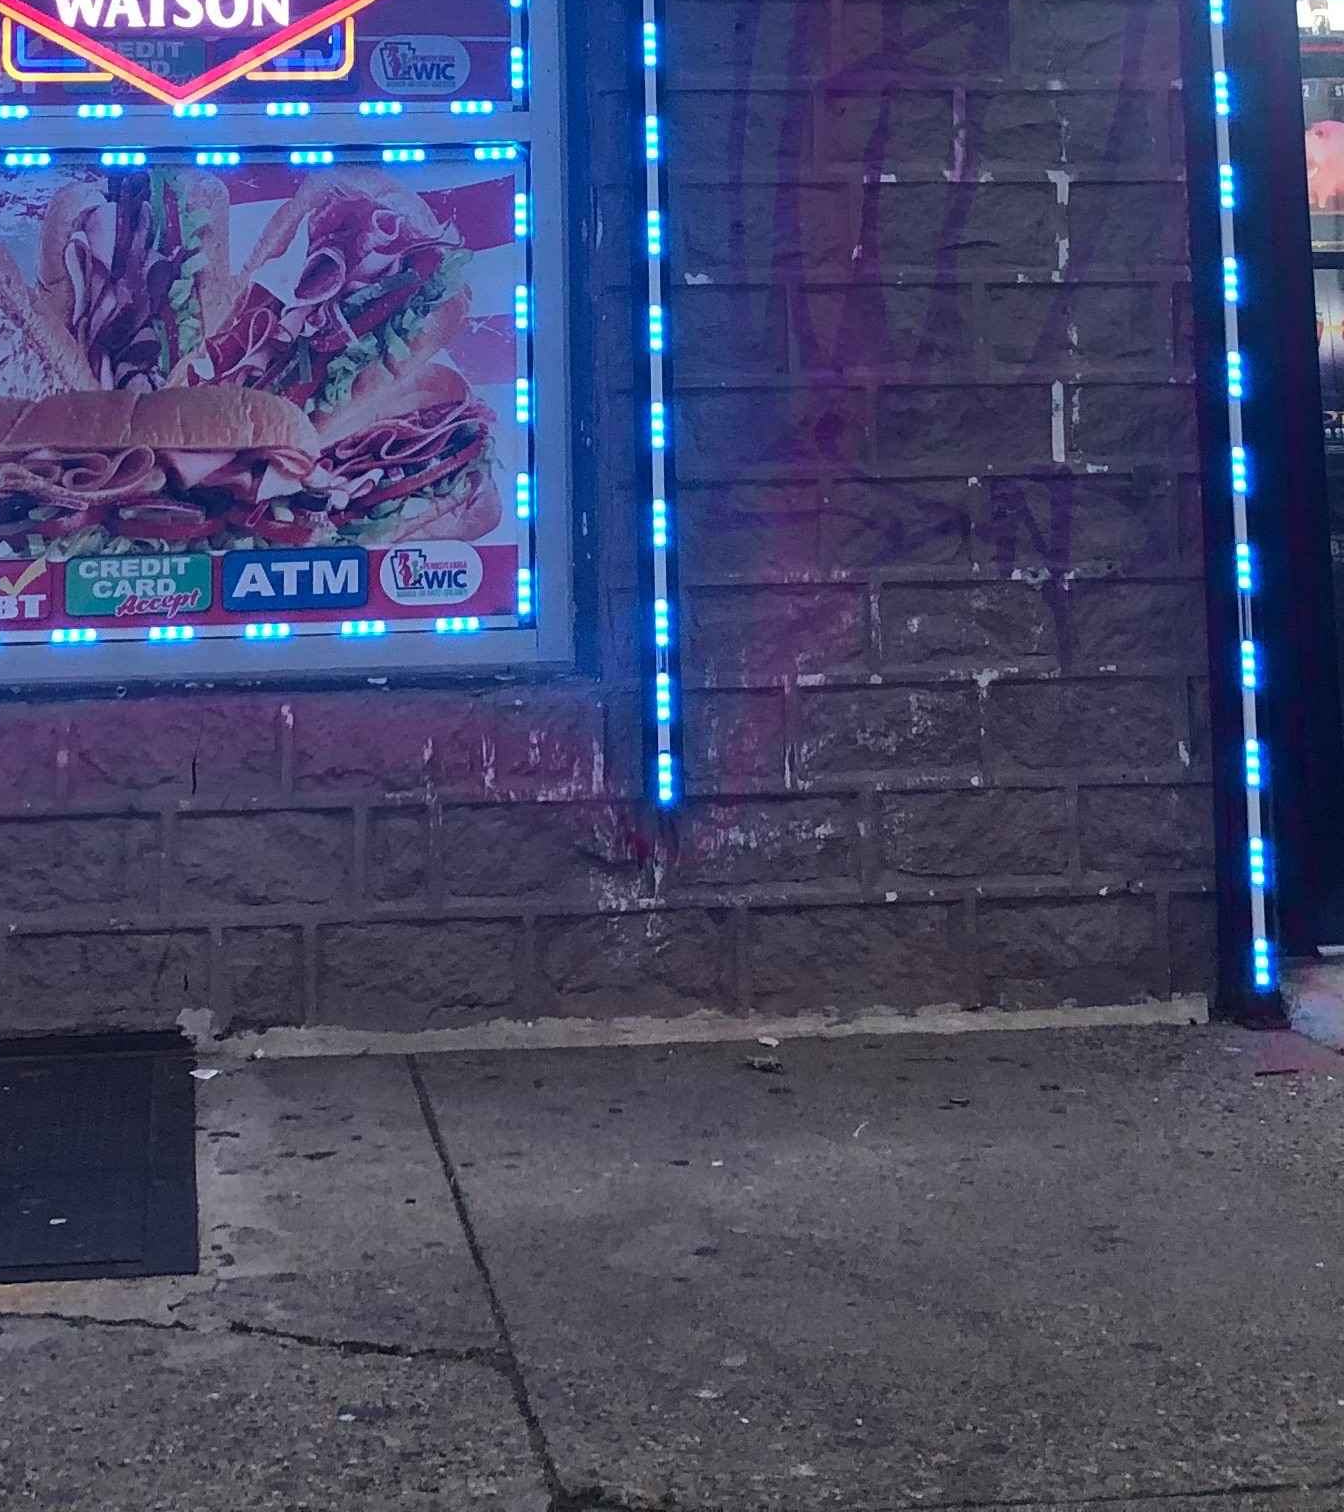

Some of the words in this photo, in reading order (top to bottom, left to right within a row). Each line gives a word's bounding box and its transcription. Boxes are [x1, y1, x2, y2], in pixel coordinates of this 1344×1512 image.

[413, 63, 456, 81] WIC
[78, 556, 191, 578] CREDIT
[92, 578, 177, 599] CARD
[231, 558, 359, 599] ATM
[423, 569, 468, 590] WIC
[114, 588, 202, 619] Accept
